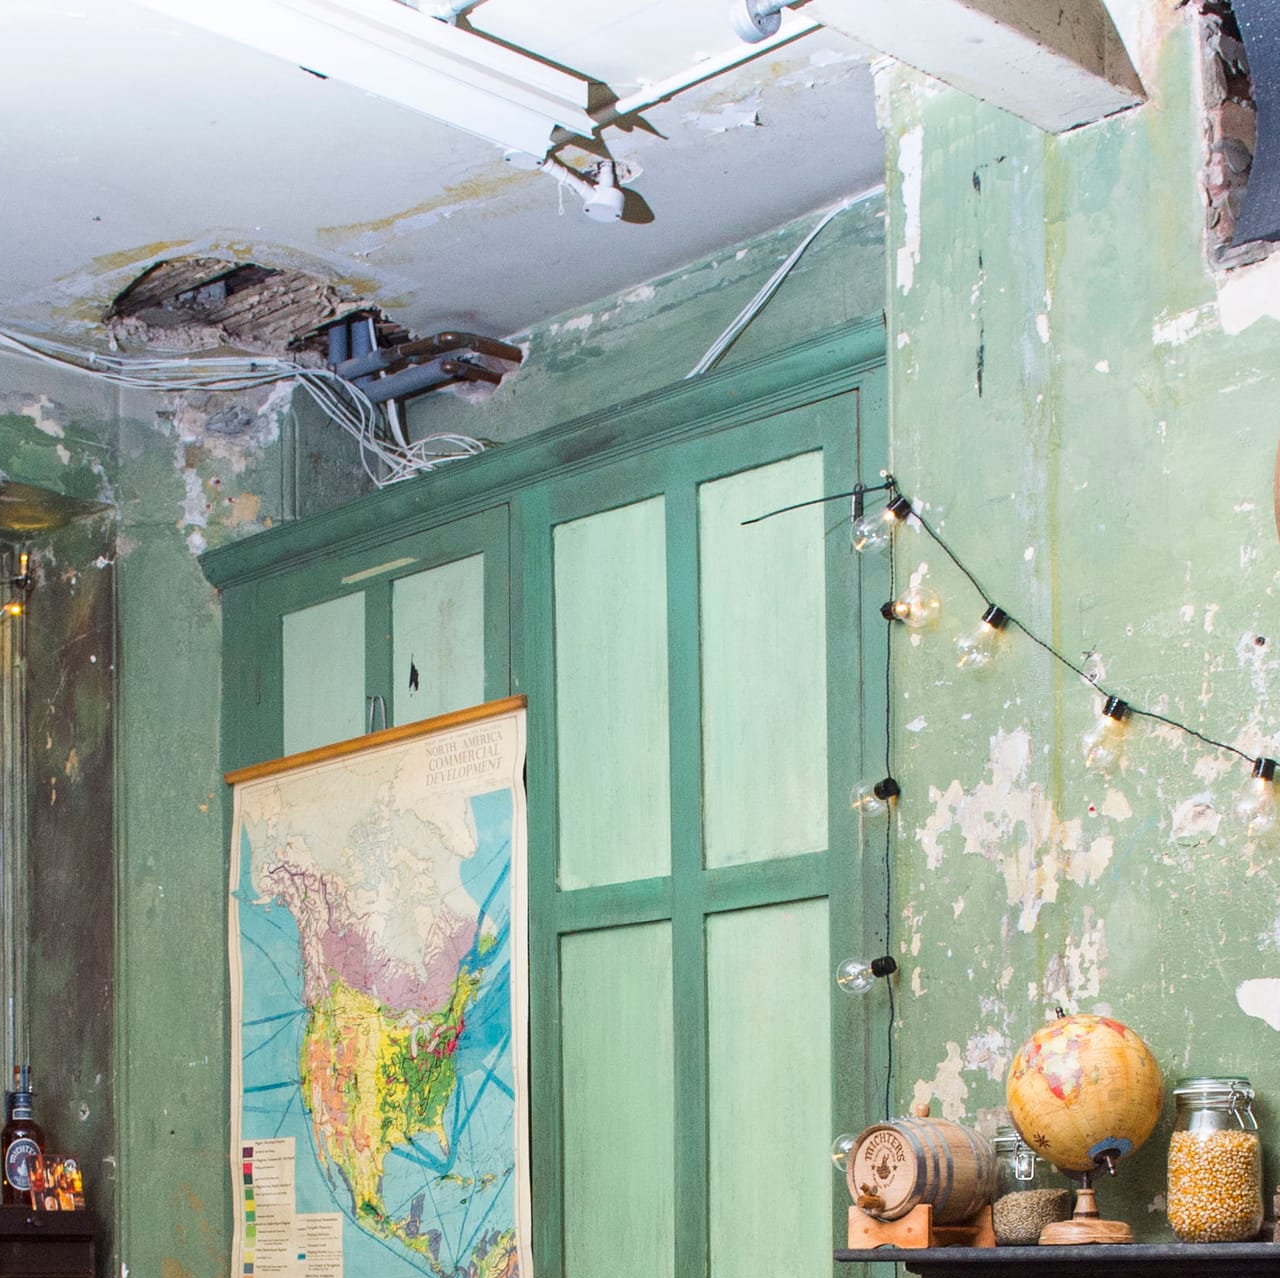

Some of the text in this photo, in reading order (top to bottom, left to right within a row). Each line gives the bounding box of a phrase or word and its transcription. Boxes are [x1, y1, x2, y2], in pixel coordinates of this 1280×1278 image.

[425, 741, 457, 758] NORTH
[463, 731, 503, 749] AMERICA
[428, 744, 501, 772] COMMERCIAL
[425, 756, 505, 786] DEVELOPMENT
